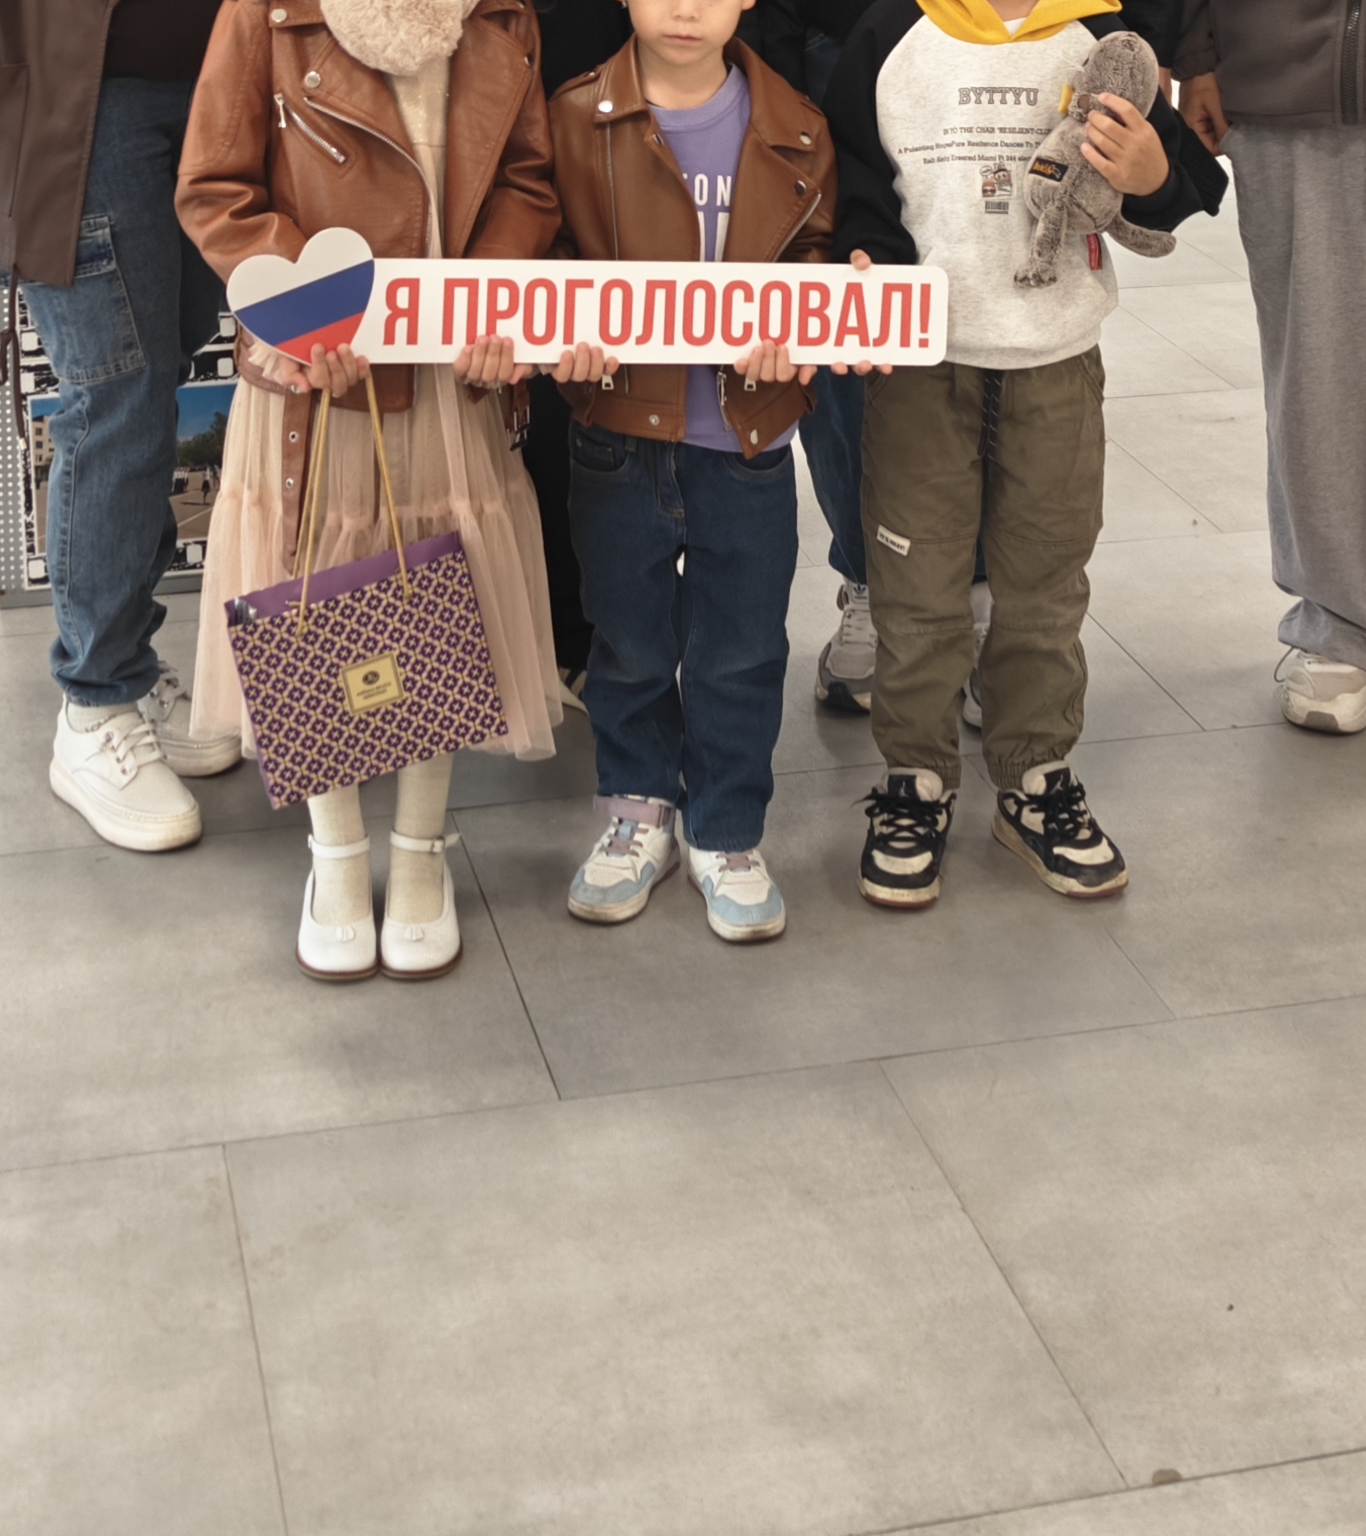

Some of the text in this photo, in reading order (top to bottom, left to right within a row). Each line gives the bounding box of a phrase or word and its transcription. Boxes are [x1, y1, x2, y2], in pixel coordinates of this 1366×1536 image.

[958, 86, 1039, 106] BYTTYU
[683, 173, 732, 207] ON
[382, 277, 932, 349] Я ПРОГОЛОСОВАЛ!
